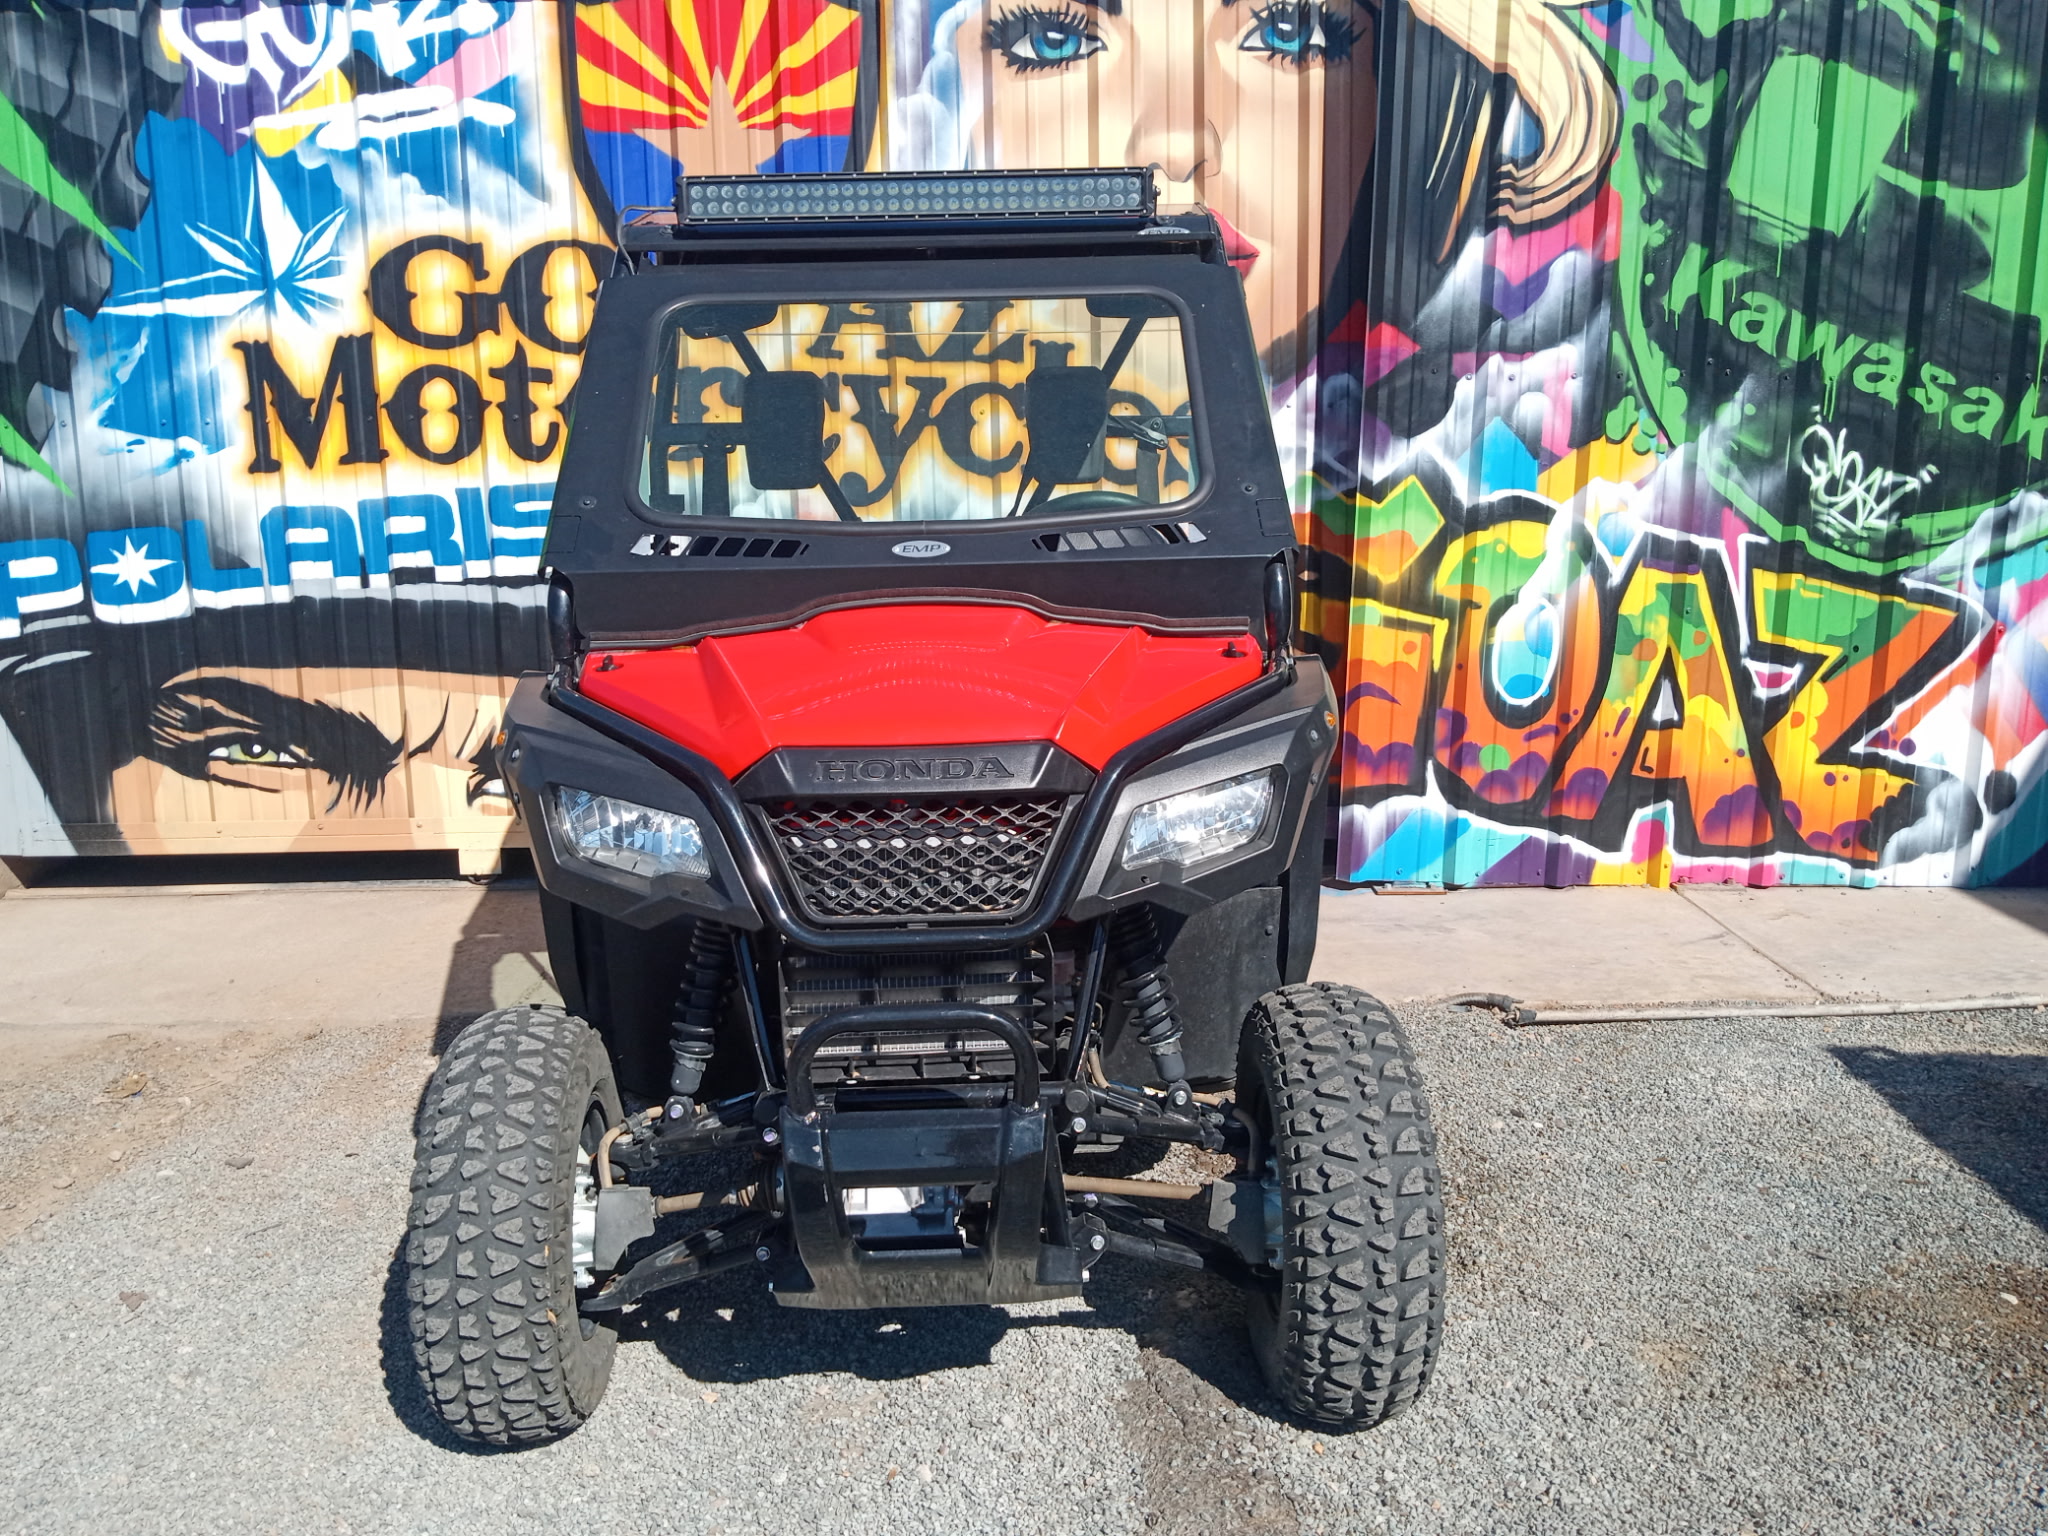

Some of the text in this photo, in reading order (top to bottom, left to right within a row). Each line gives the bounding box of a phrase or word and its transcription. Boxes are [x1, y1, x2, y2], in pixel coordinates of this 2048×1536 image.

[363, 234, 617, 355] GO
[0, 482, 559, 637] POLARIS
[902, 544, 941, 553] EMP
[816, 756, 1015, 783] HONDA
